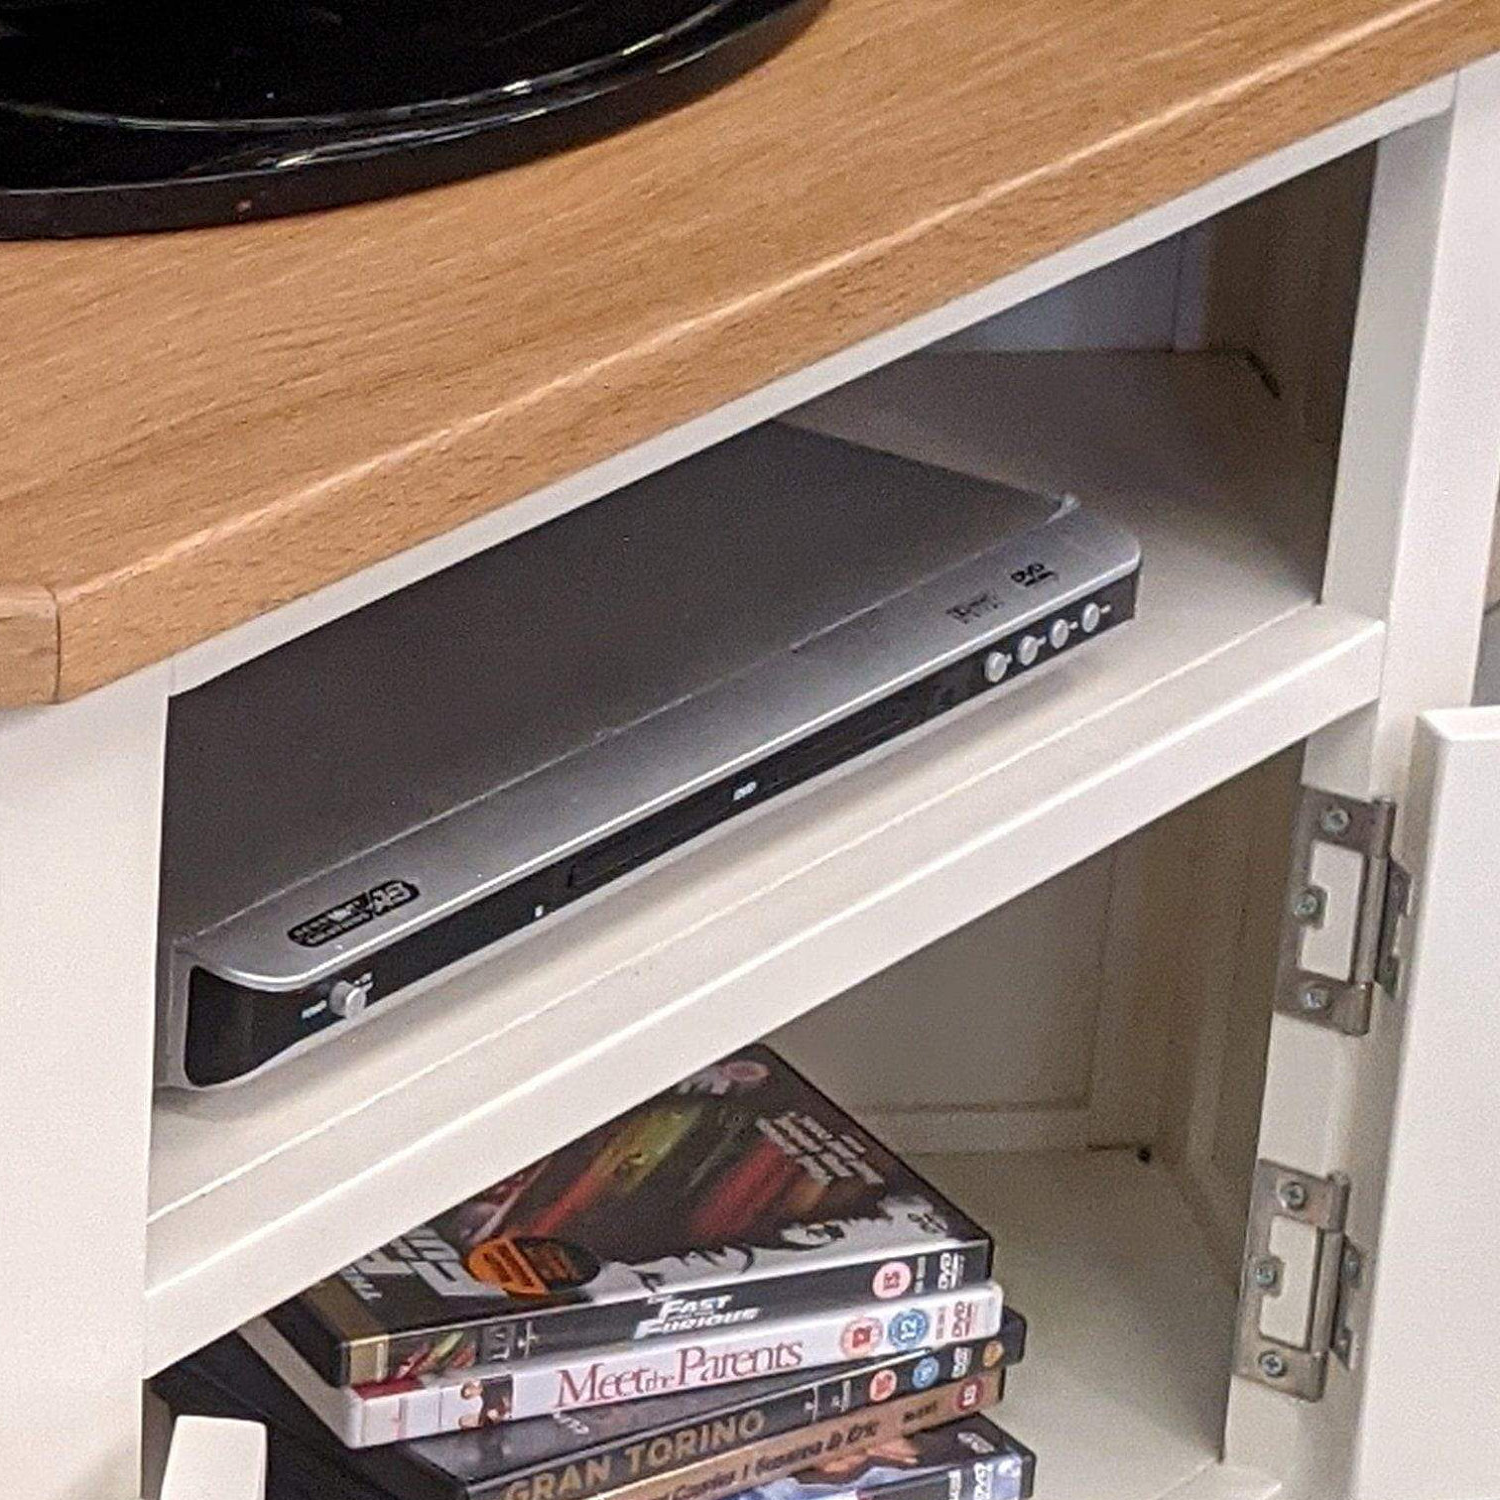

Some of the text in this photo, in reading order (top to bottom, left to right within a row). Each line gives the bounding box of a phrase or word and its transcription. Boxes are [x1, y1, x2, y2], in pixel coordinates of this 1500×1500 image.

[633, 1307, 762, 1340] FURIOUS
[659, 1294, 734, 1321] FAST
[555, 1362, 651, 1408] Meet
[675, 1339, 804, 1386] Parents
[624, 1408, 767, 1474] TORINO
